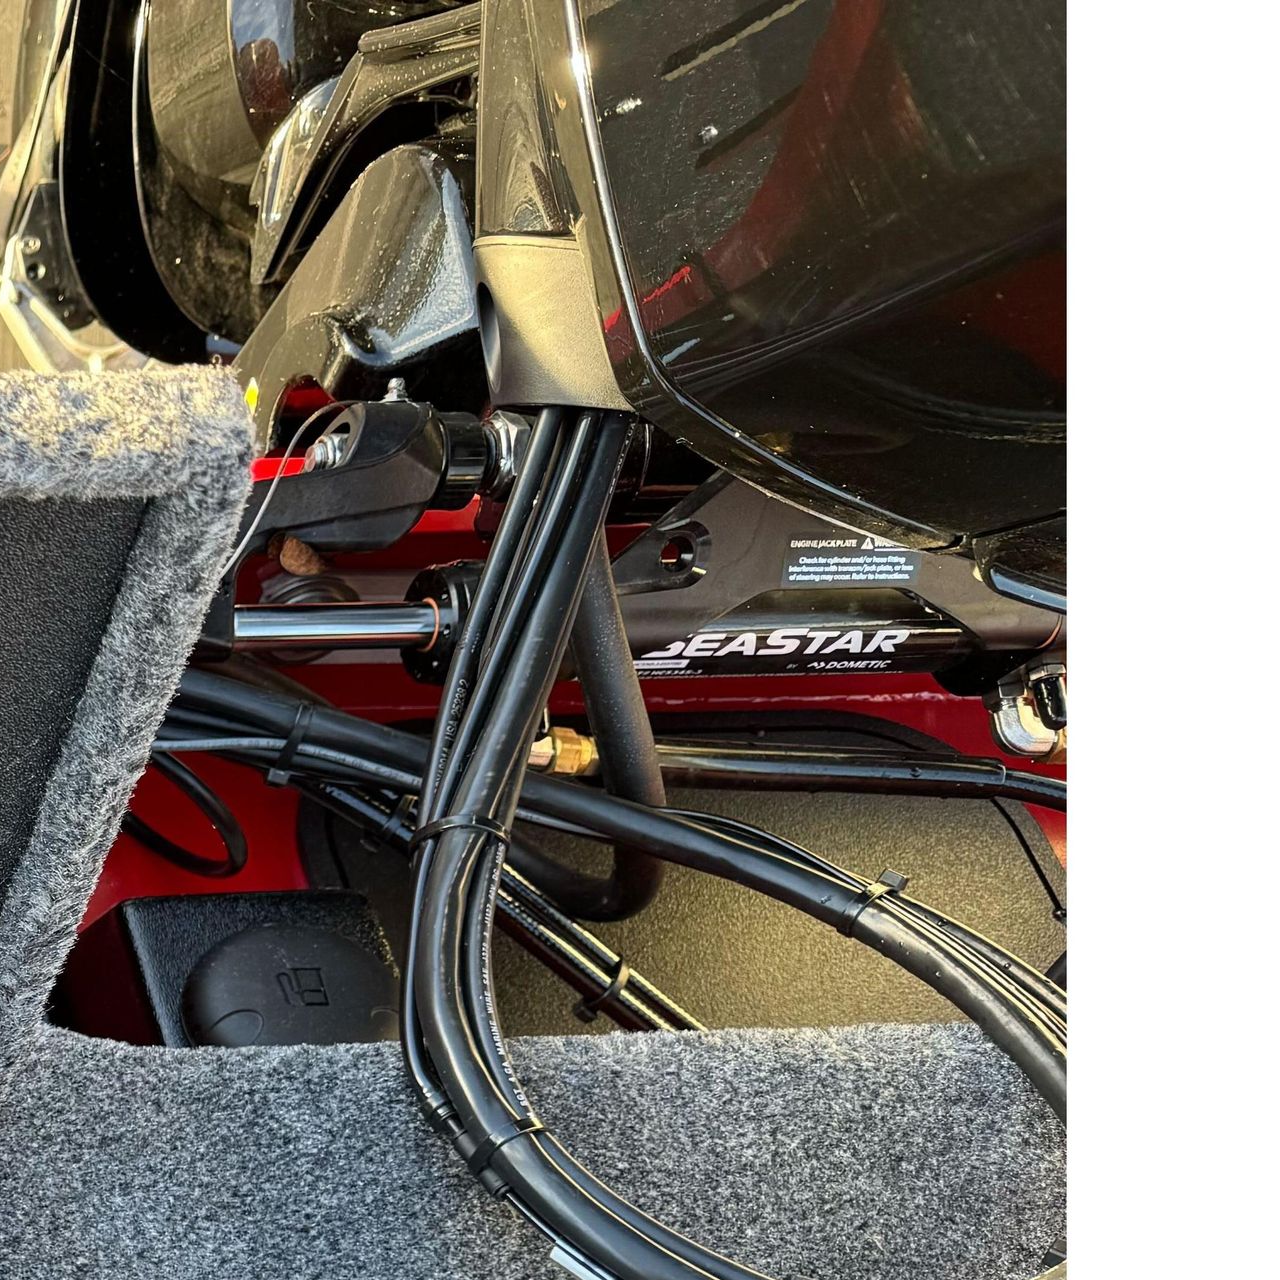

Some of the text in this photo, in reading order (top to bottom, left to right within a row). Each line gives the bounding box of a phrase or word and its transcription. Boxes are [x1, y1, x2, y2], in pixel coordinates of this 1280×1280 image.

[790, 539, 858, 549] ENGINE JACK PLATE
[824, 660, 892, 670] DOMETIC
[489, 1020, 506, 1056] MARINE
